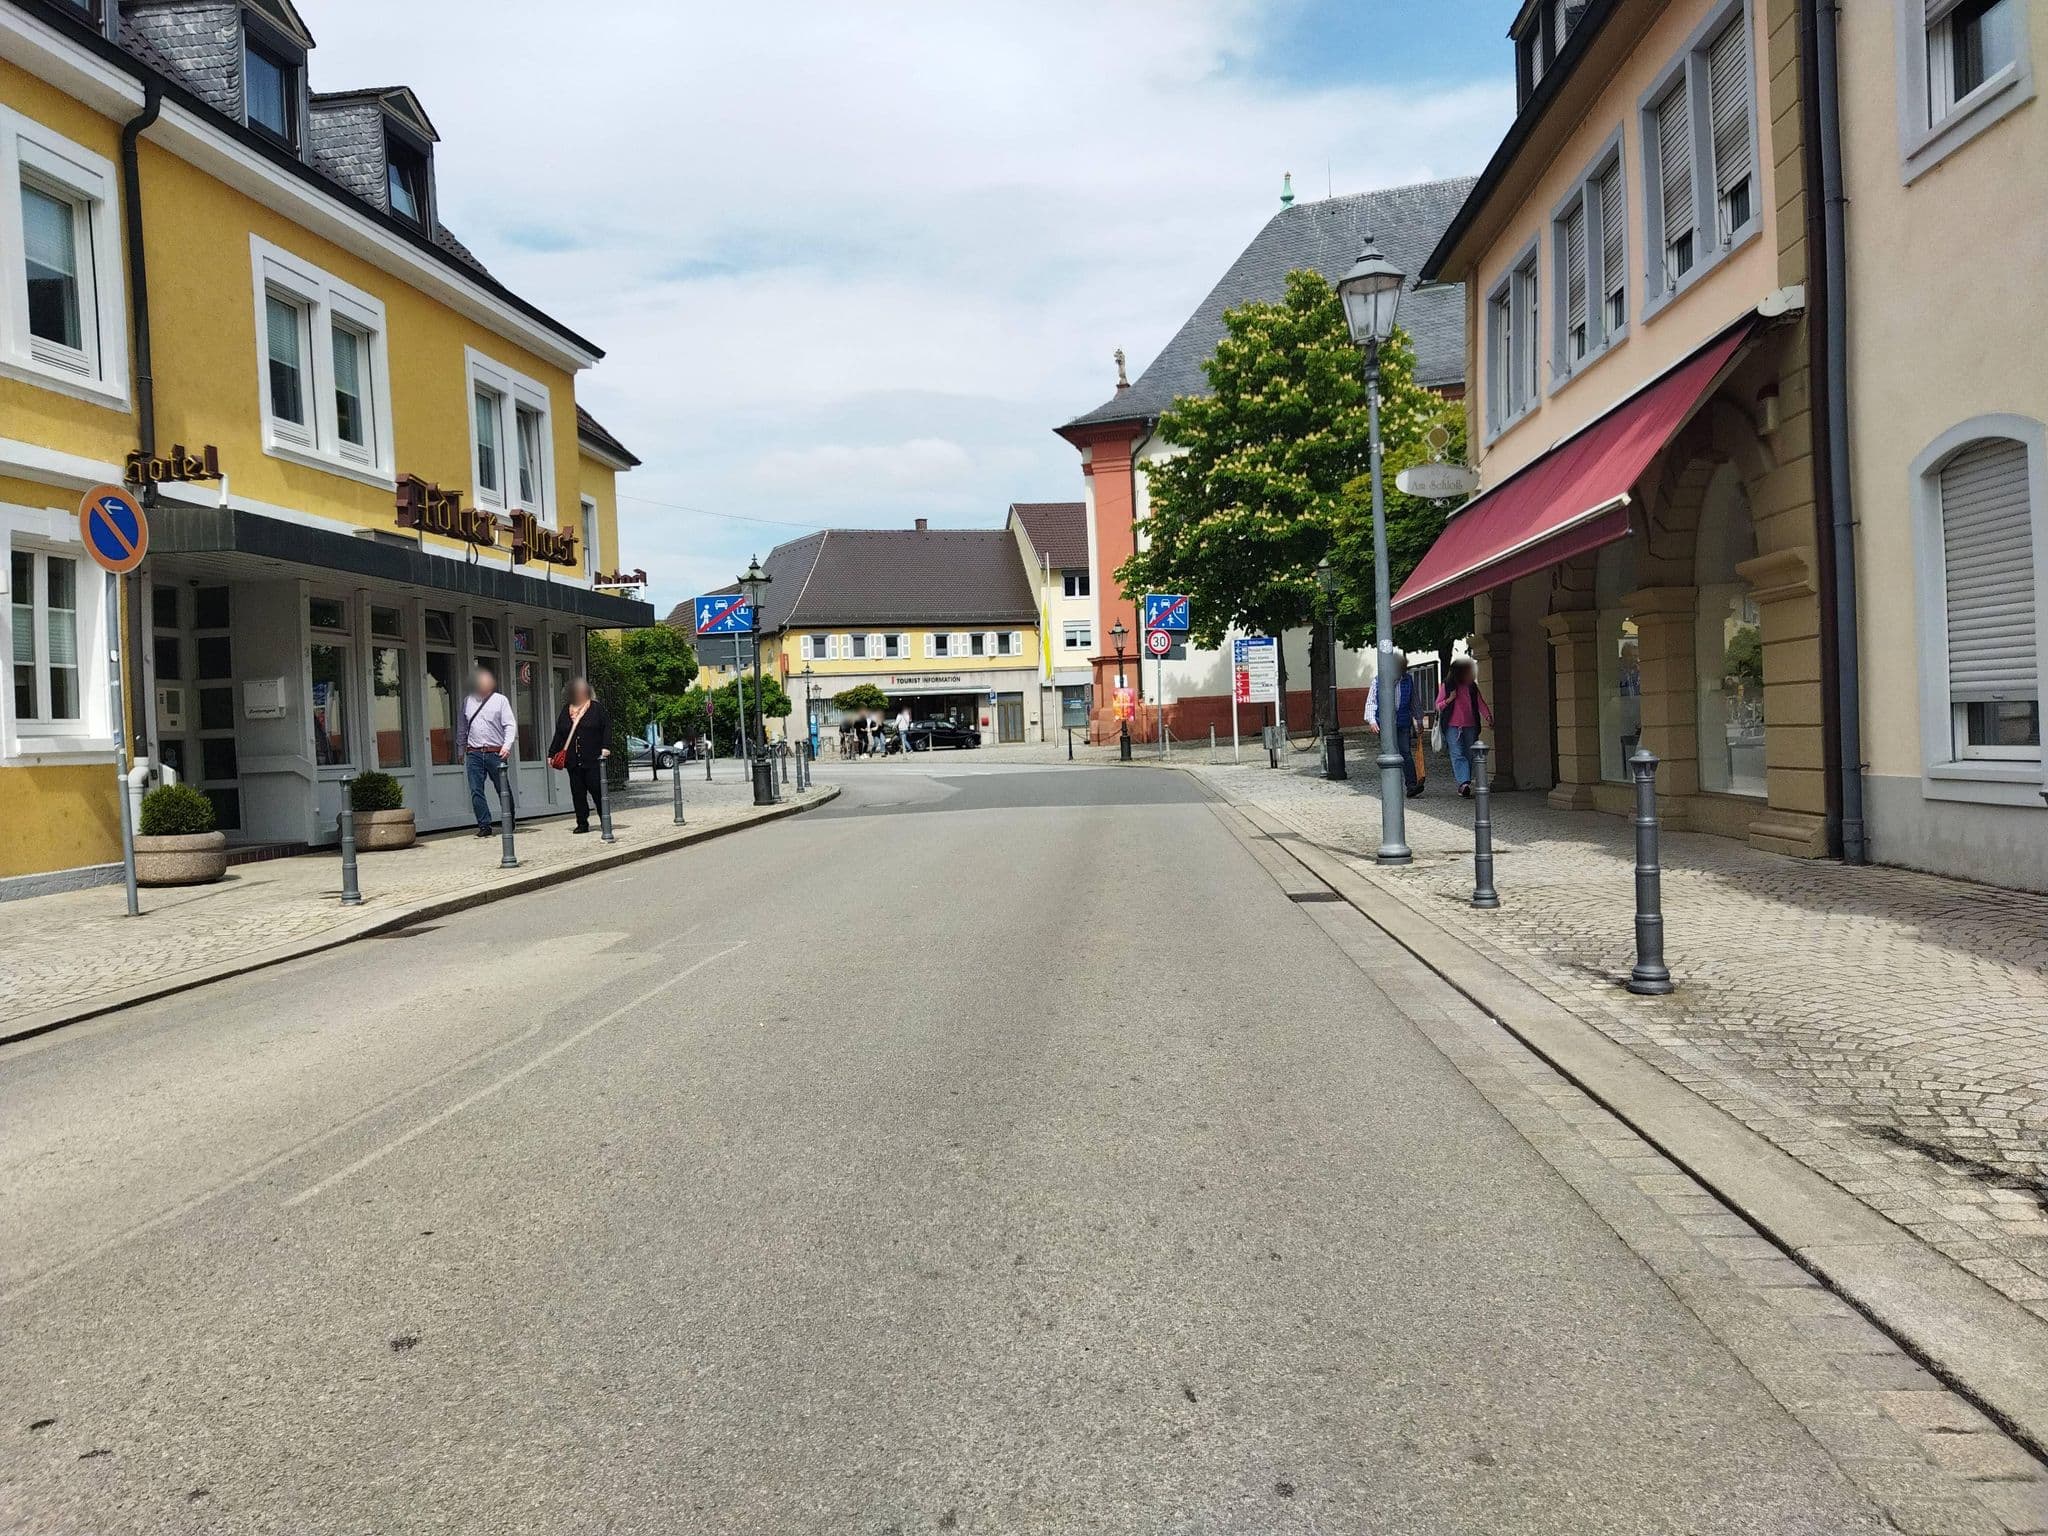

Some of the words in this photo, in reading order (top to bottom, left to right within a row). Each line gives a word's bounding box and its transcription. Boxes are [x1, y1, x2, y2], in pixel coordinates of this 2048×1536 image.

[1152, 636, 1166, 648] 30
[896, 677, 920, 685] TOURIST
[922, 675, 961, 684] INFORMATION
